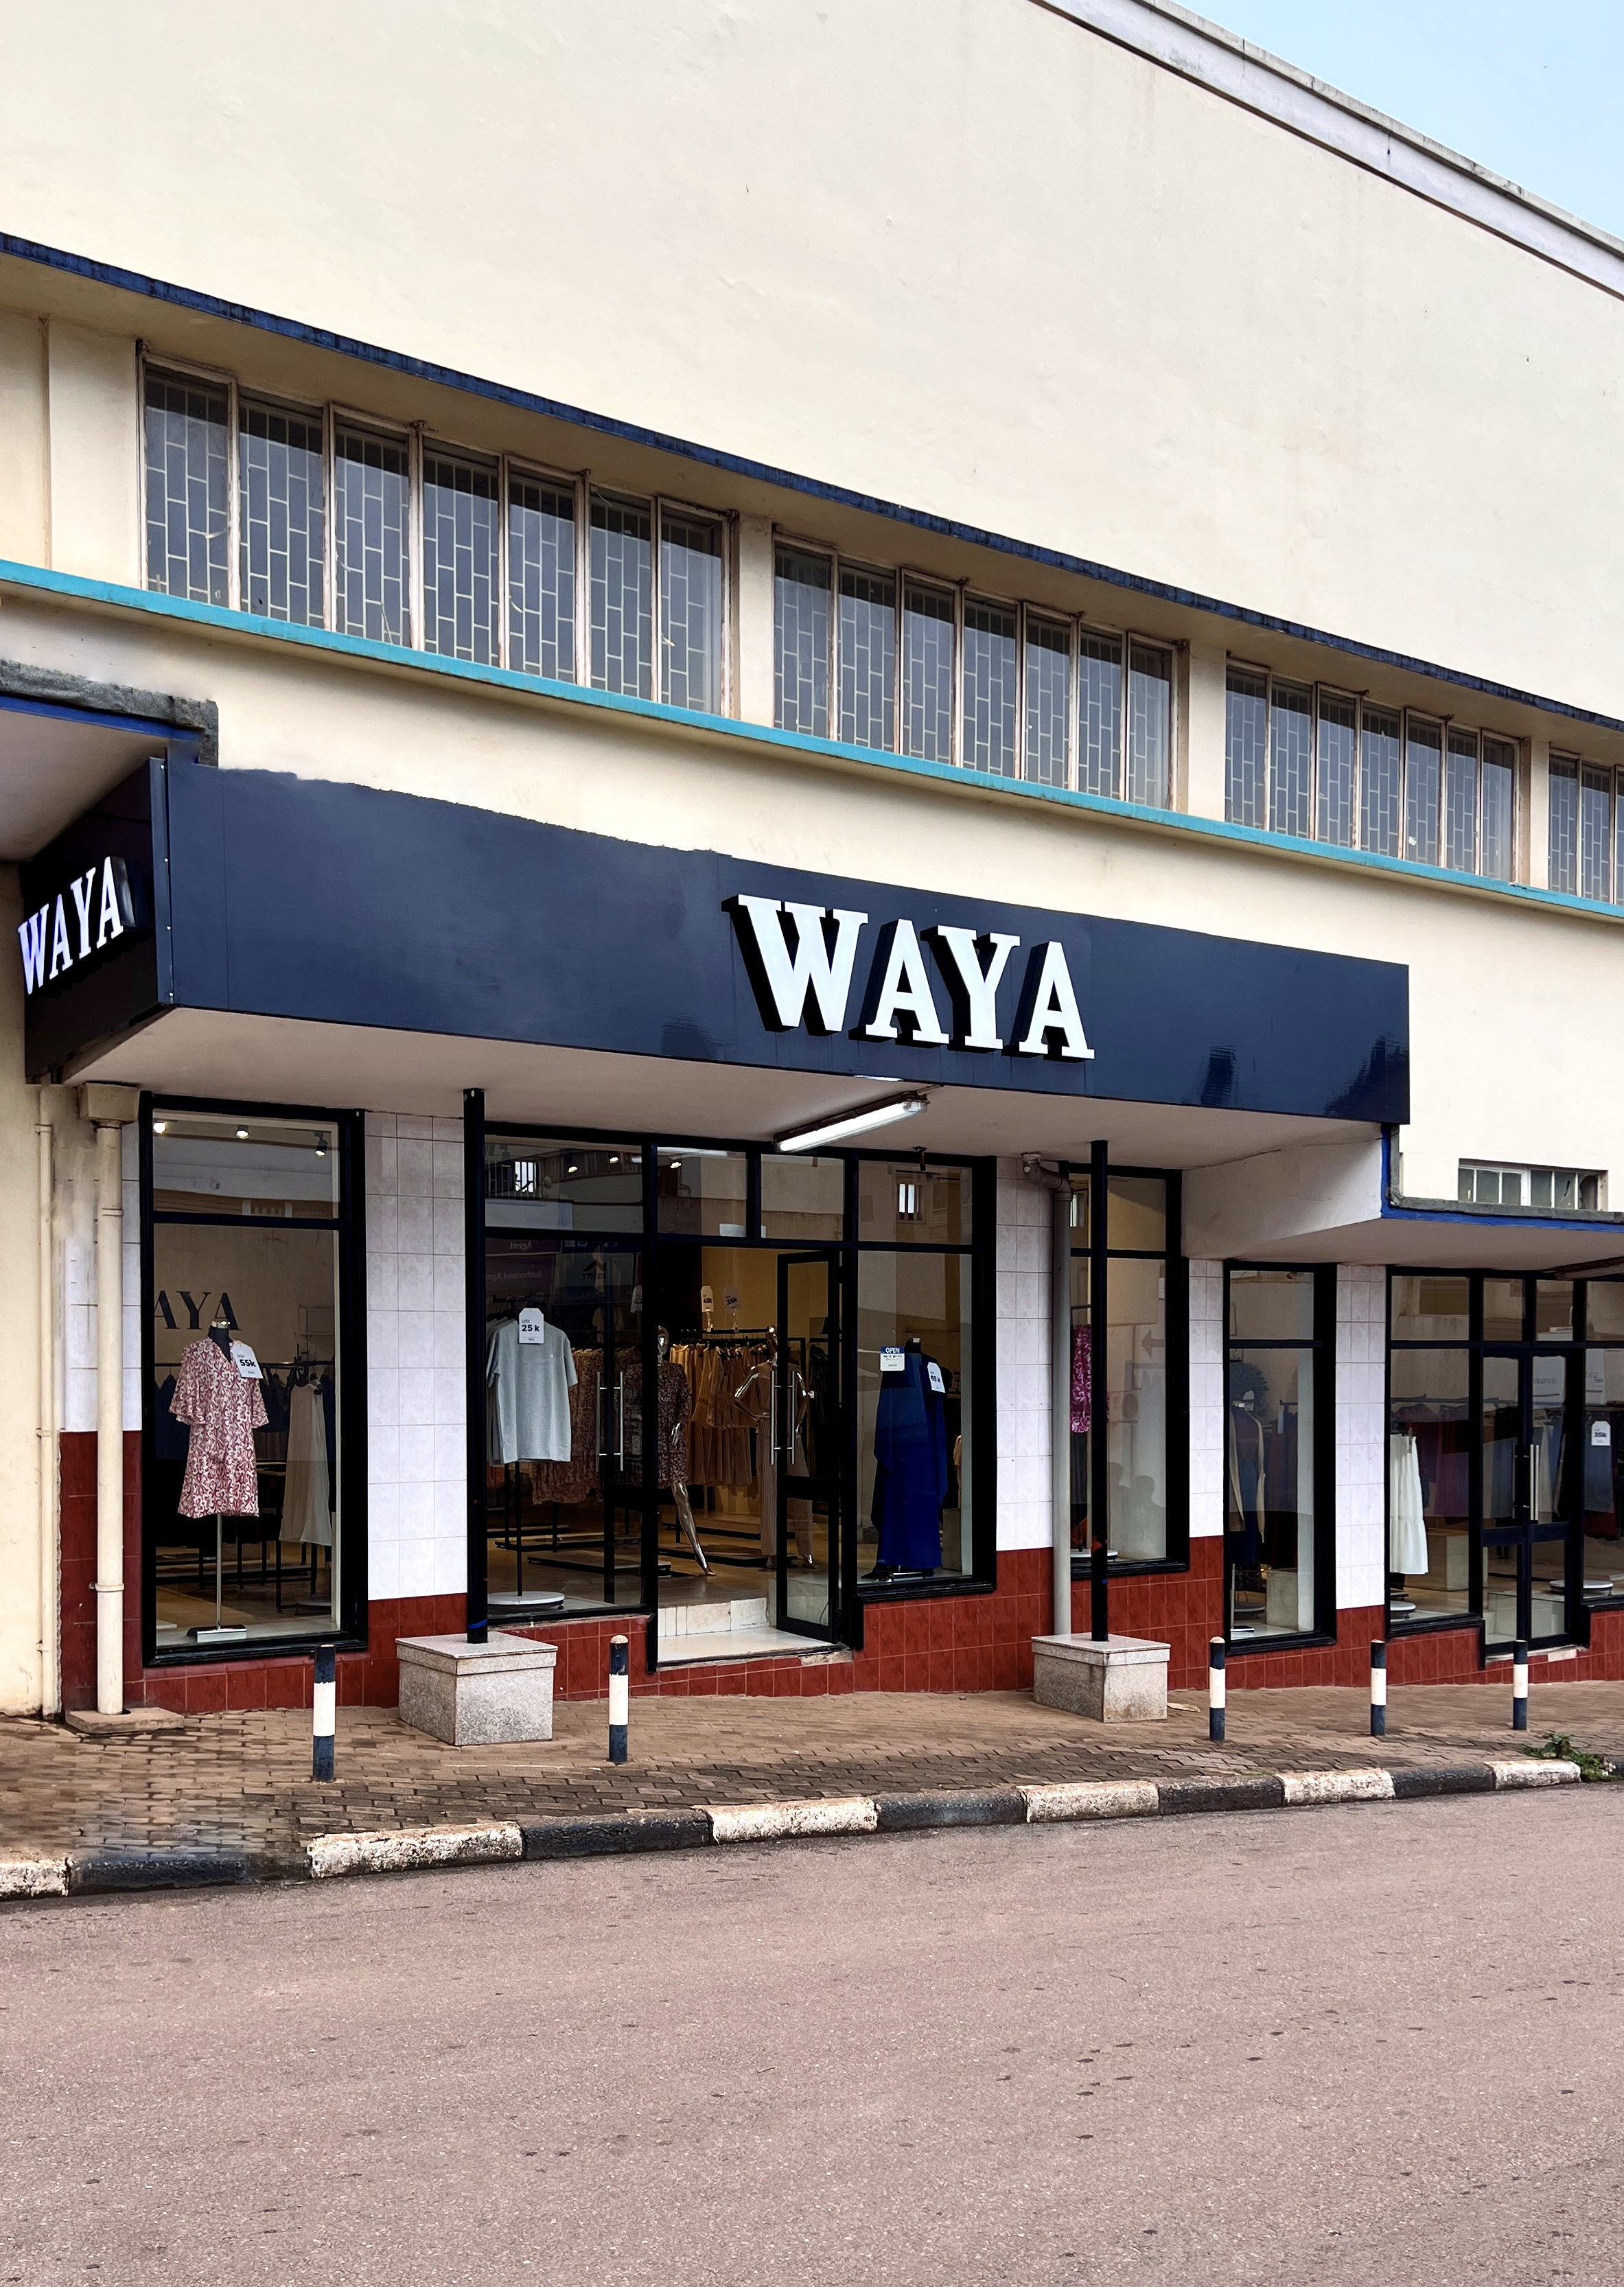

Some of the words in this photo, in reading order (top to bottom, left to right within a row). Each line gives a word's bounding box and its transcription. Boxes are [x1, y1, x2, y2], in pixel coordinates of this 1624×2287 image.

[18, 857, 124, 995] WAYA
[738, 894, 1095, 1060] WAYA
[239, 1359, 256, 1367] 55k
